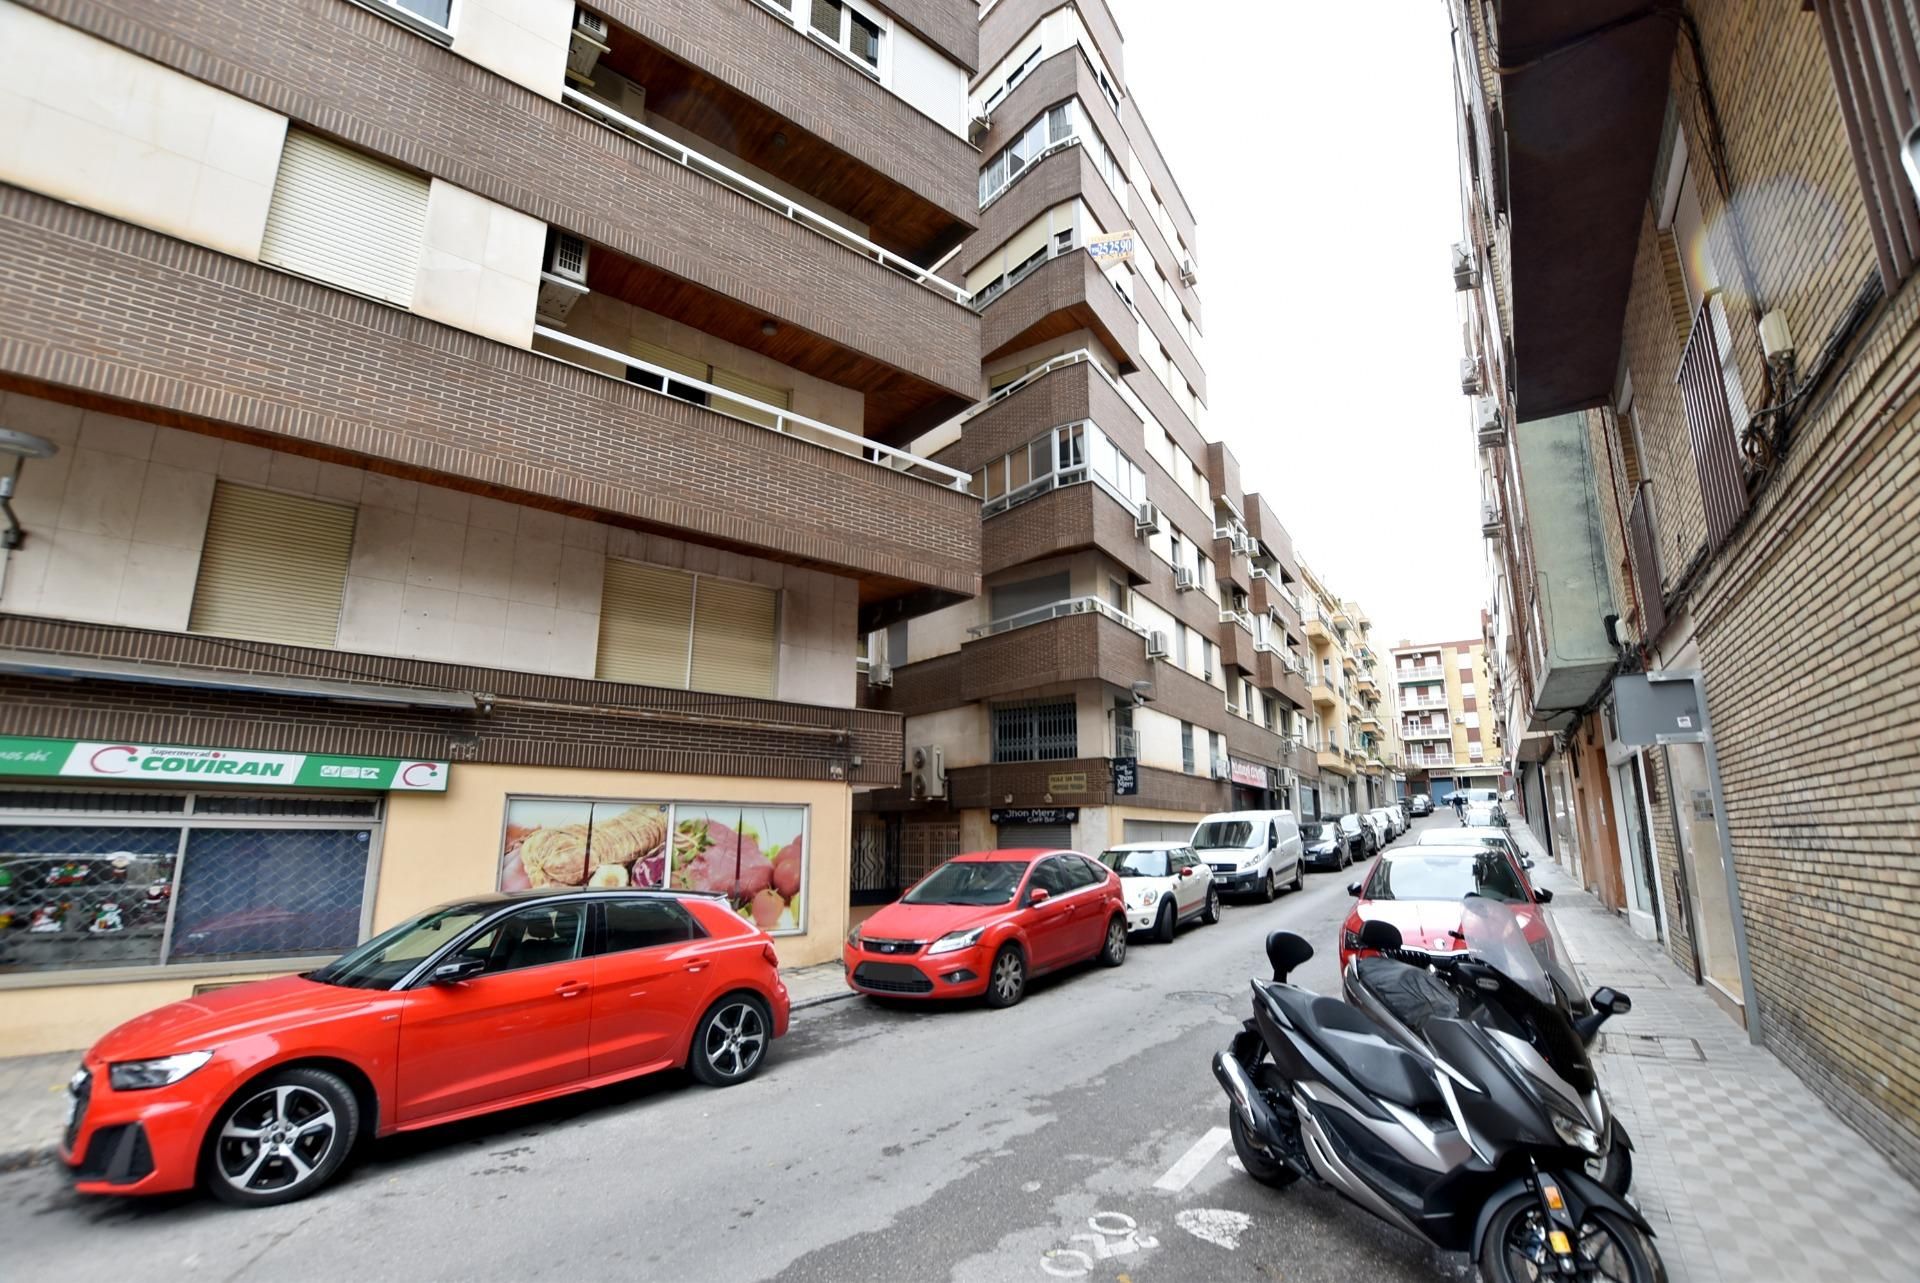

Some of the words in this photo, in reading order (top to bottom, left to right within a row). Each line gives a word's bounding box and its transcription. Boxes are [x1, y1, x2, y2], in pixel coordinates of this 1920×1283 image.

[140, 756, 284, 777] COVIRAN
[1006, 809, 1029, 817] Jhon
[1031, 808, 1056, 817] Mery
